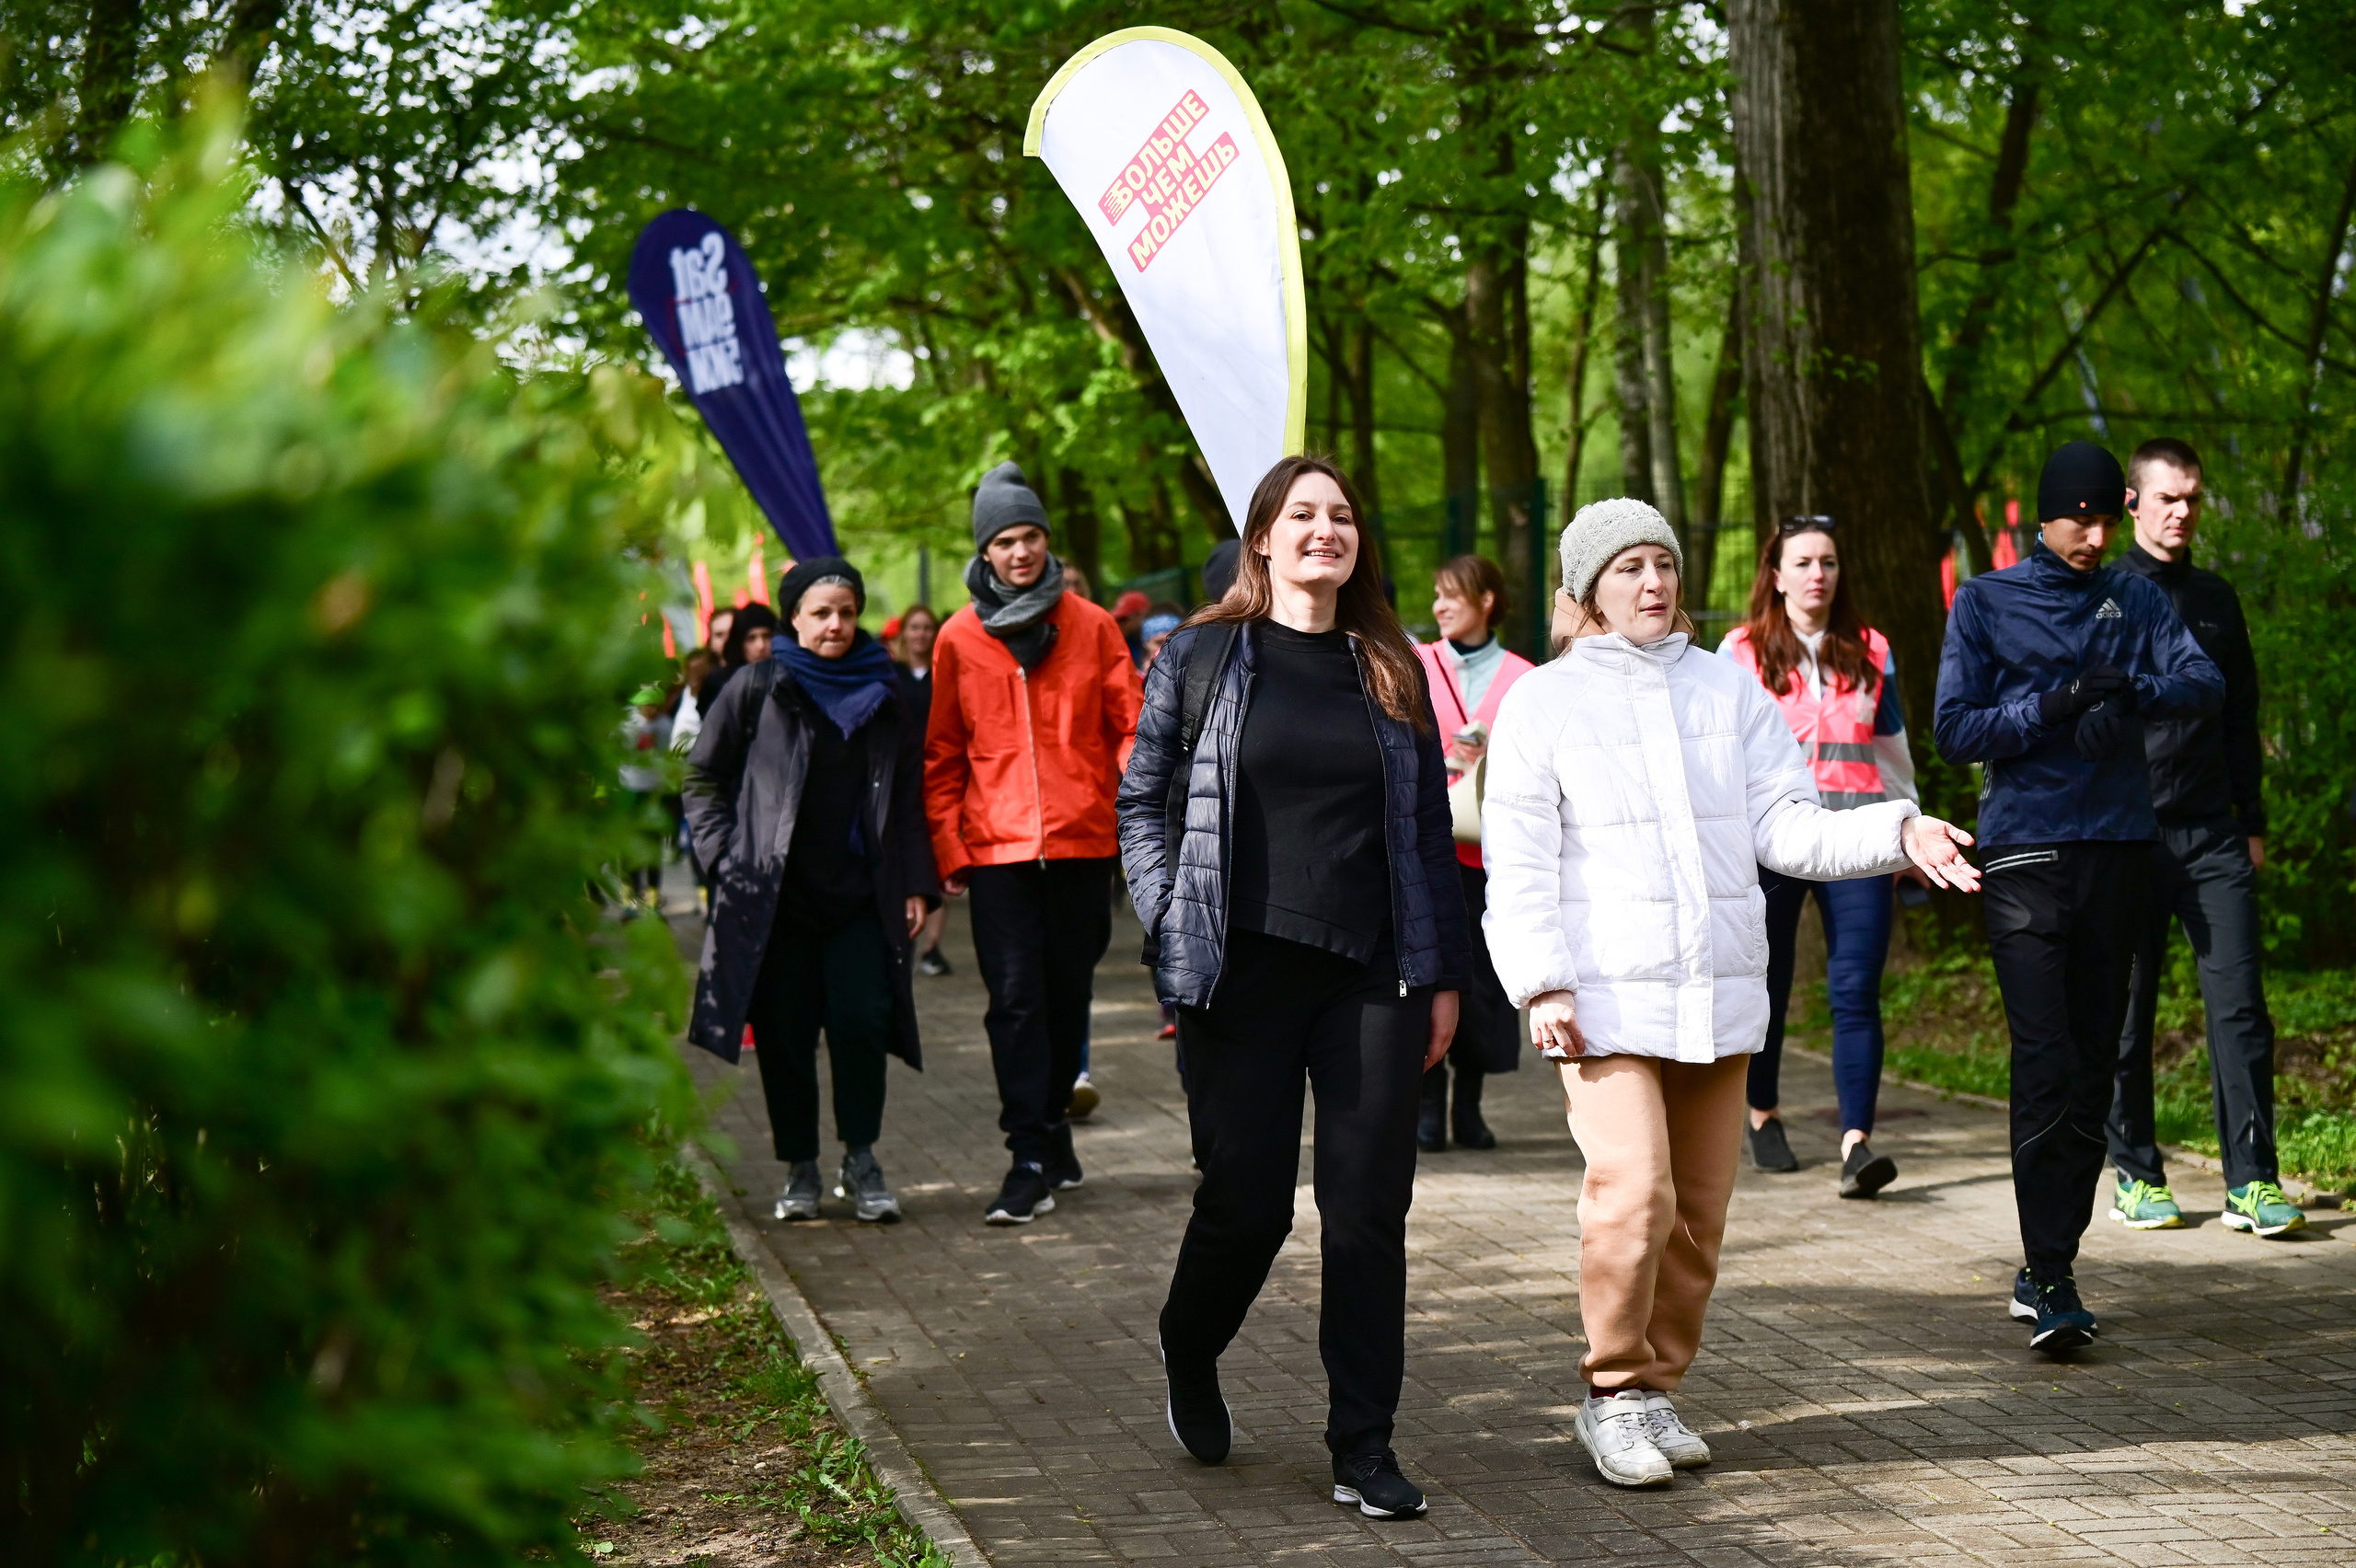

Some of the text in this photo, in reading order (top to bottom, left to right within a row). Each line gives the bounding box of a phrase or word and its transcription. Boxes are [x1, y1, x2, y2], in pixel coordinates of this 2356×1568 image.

[1103, 92, 1207, 222] БОЛЬШЕ
[1130, 143, 1236, 268] МОЖЕШЬ
[1140, 144, 1195, 207] ЧЕМ
